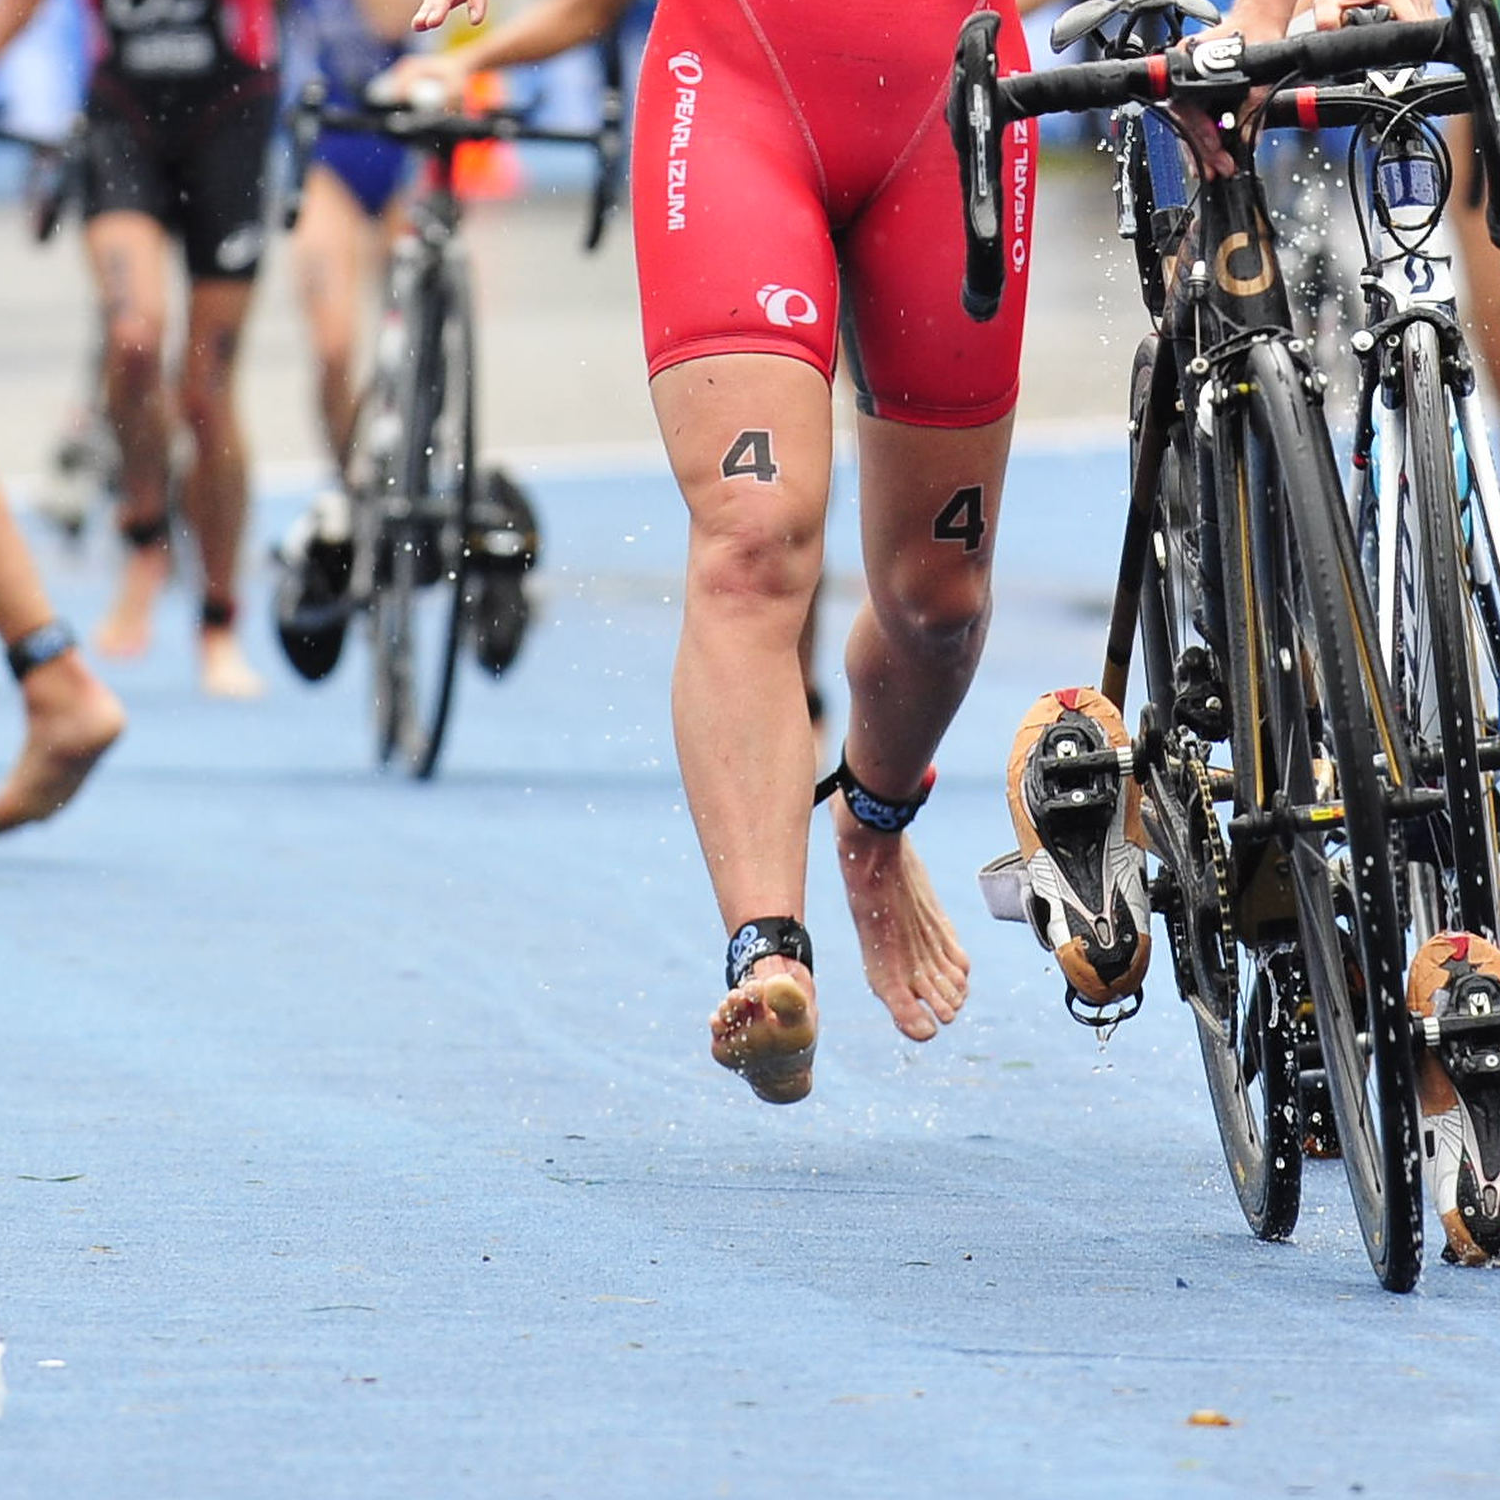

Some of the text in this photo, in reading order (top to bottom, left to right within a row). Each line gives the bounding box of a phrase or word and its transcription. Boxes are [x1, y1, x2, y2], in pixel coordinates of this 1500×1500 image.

[669, 87, 696, 157] PEARL
[1014, 148, 1029, 233] PEARL
[720, 429, 780, 484] 4
[932, 484, 986, 553] 4
